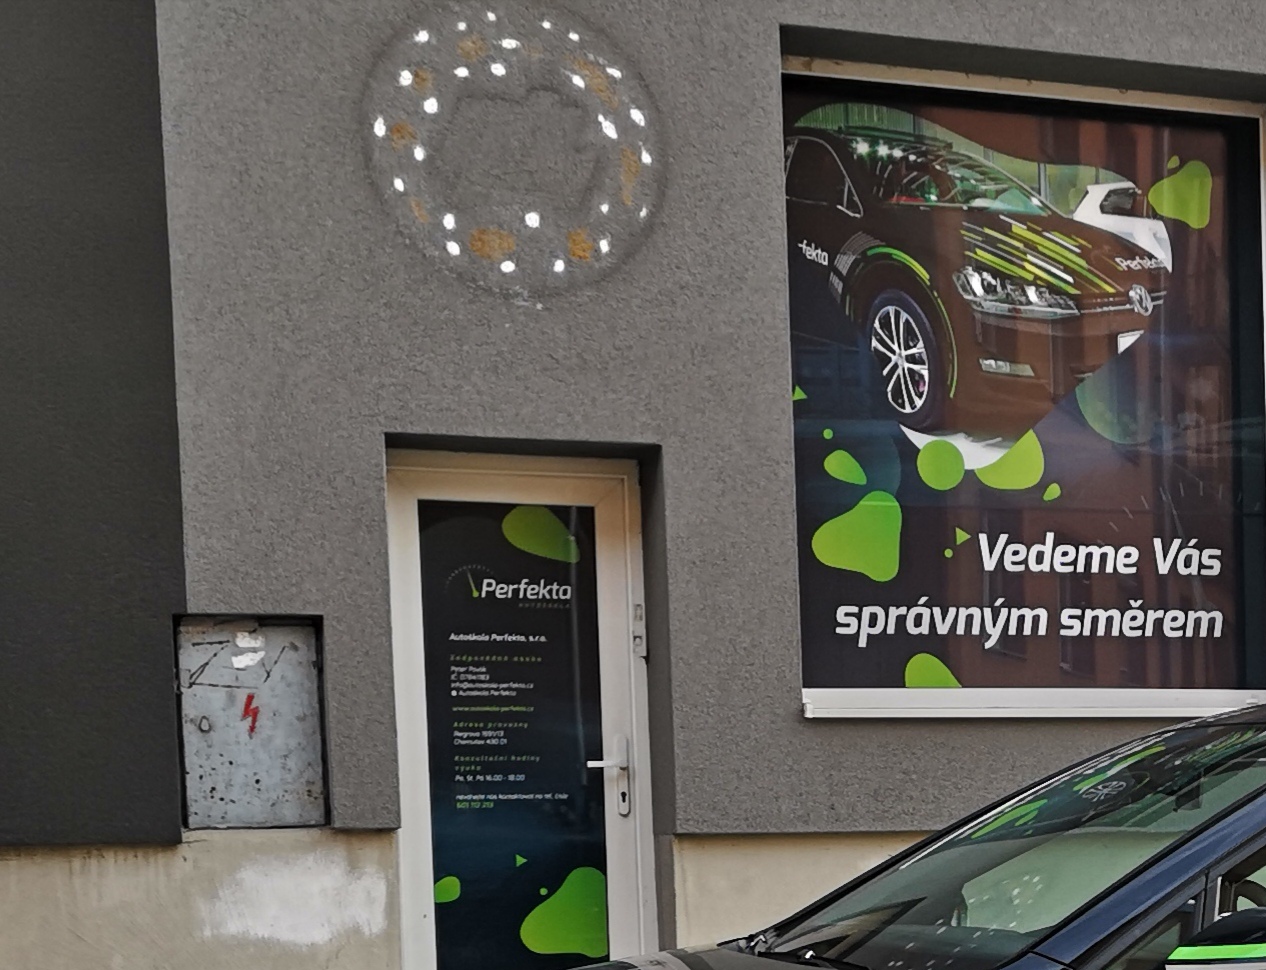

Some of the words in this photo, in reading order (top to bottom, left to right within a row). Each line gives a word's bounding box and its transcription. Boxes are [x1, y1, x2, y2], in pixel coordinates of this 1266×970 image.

[978, 532, 1140, 576] Vedeme
[1153, 536, 1223, 577] Vás
[481, 578, 572, 600] Perfekta
[835, 595, 1049, 650] správným
[1059, 599, 1223, 639] směrem
